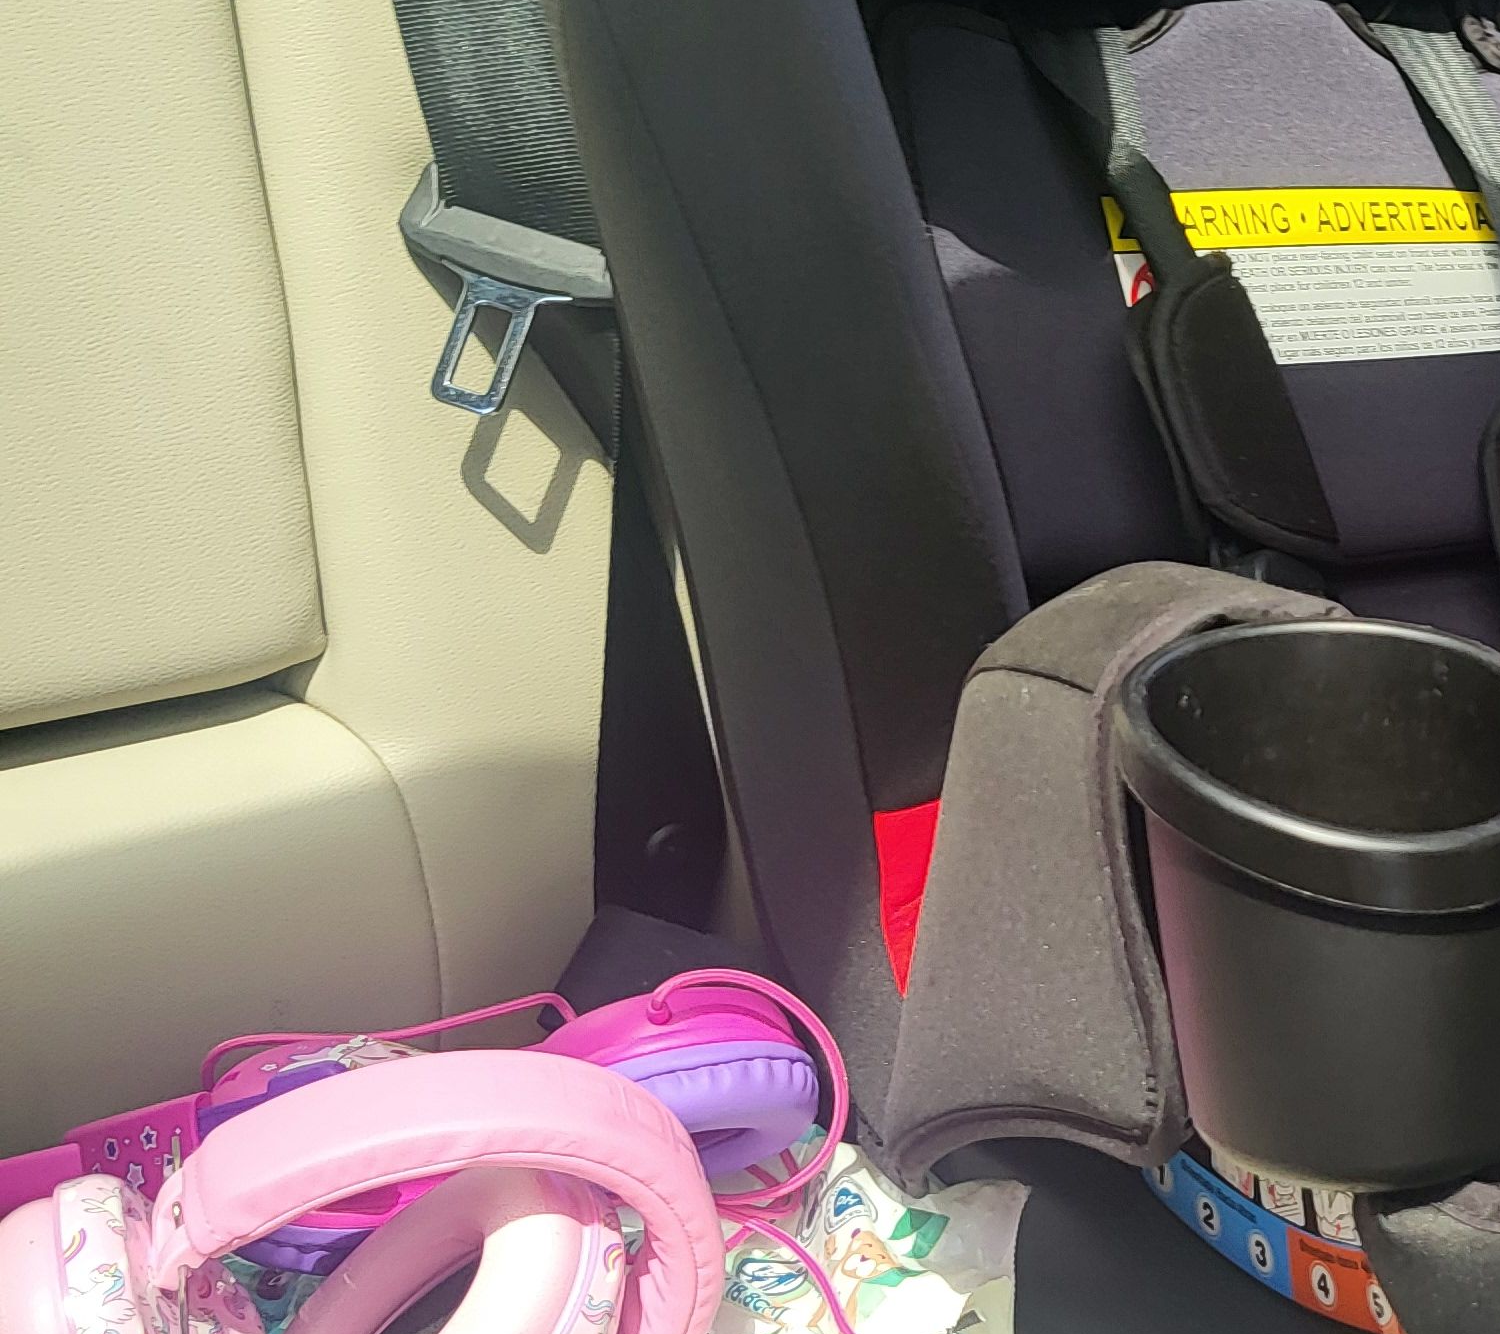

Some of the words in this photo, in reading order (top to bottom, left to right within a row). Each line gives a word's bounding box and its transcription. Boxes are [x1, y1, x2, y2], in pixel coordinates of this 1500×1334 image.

[1184, 201, 1291, 236] ARNING
[1317, 200, 1495, 233] ADVERTENCIA
[1202, 1201, 1216, 1231] 2
[1254, 1239, 1268, 1268] 3
[1316, 1272, 1331, 1299] 4
[1371, 1291, 1385, 1319] 5
